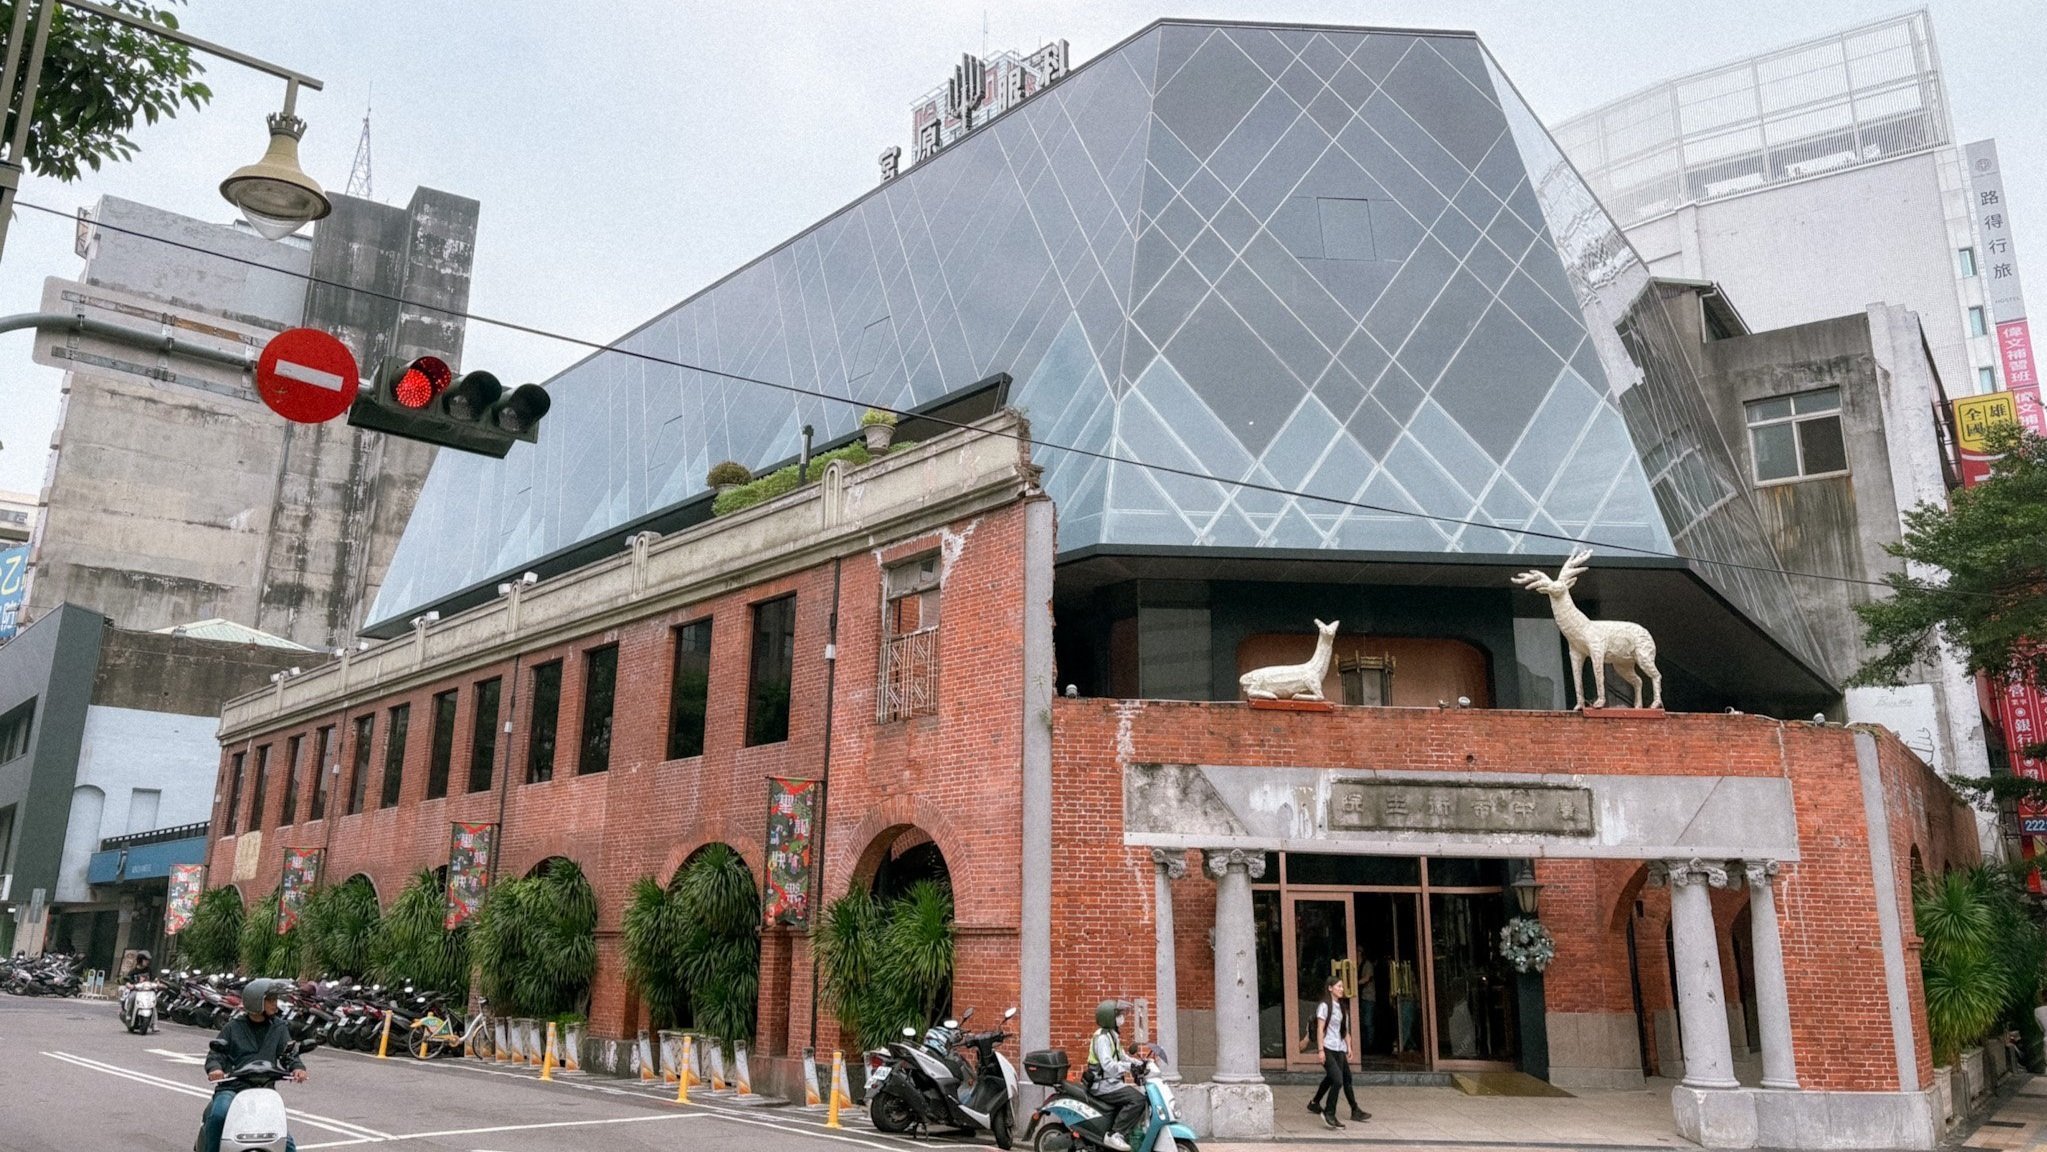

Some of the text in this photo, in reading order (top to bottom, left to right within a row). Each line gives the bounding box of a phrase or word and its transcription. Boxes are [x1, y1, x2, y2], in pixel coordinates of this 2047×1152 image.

[1980, 189, 2013, 280] 路得行旅
[1964, 407, 1987, 438] 全國
[2015, 718, 2034, 749] 銀行
[2025, 819, 2047, 832] 222
